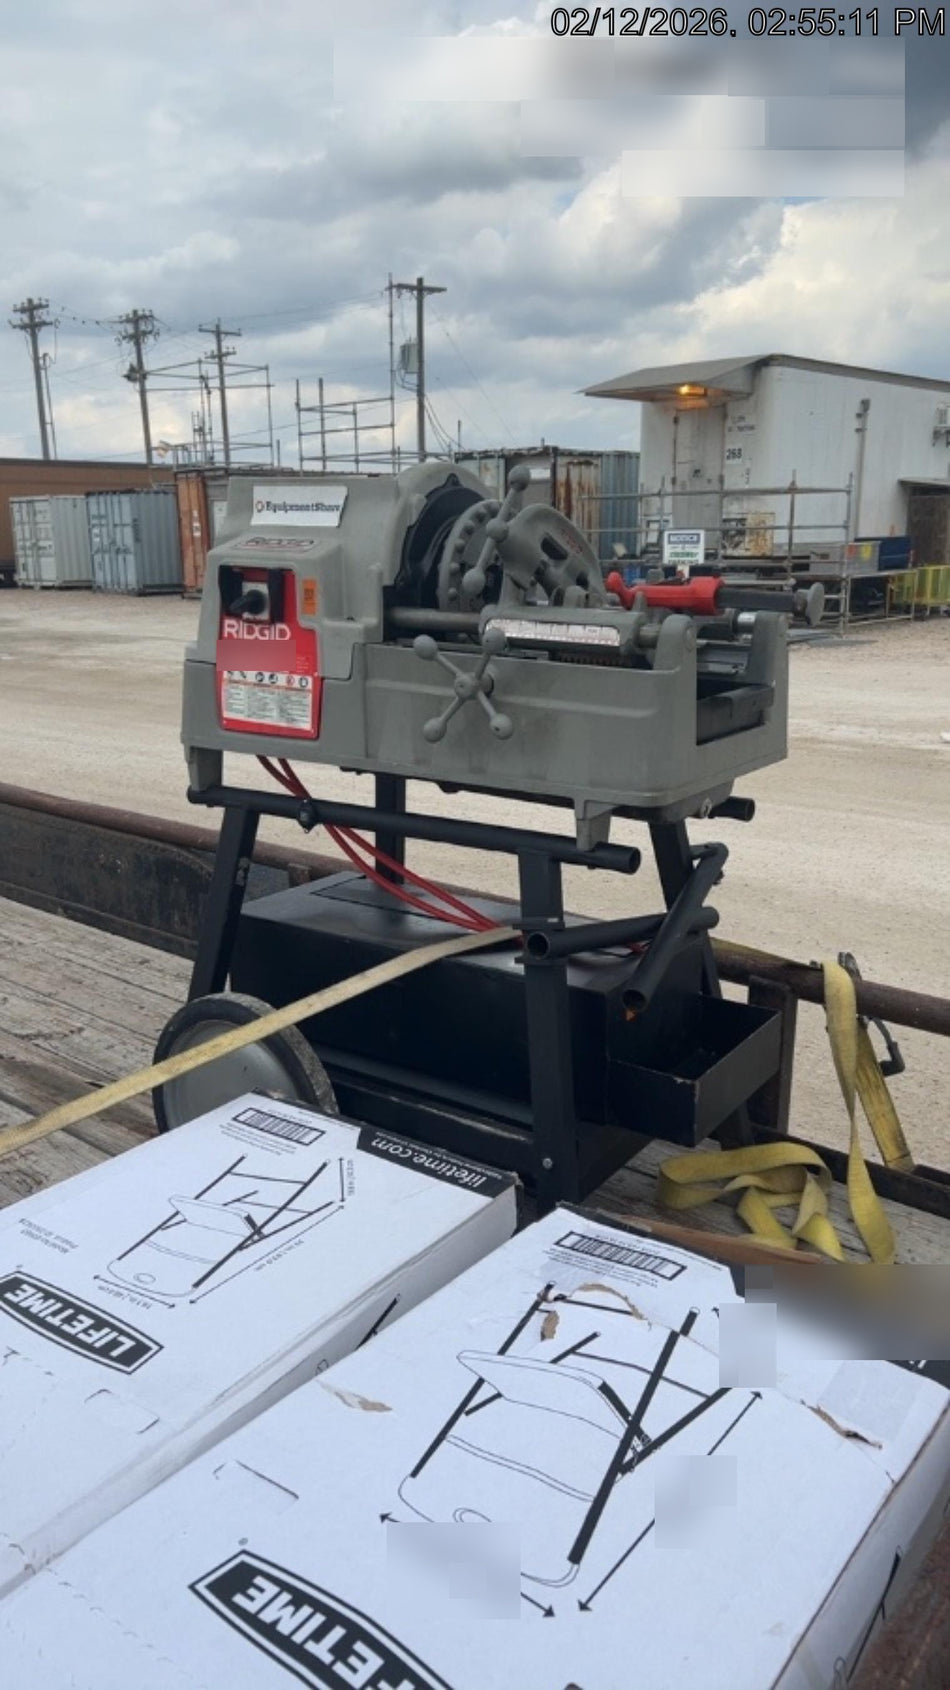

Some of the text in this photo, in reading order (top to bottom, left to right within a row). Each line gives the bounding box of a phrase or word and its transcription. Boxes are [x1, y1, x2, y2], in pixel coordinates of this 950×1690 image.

[223, 619, 292, 641] RIDGID
[371, 1138, 488, 1188] lifetime.com
[3, 1283, 137, 1358] LIFETIME
